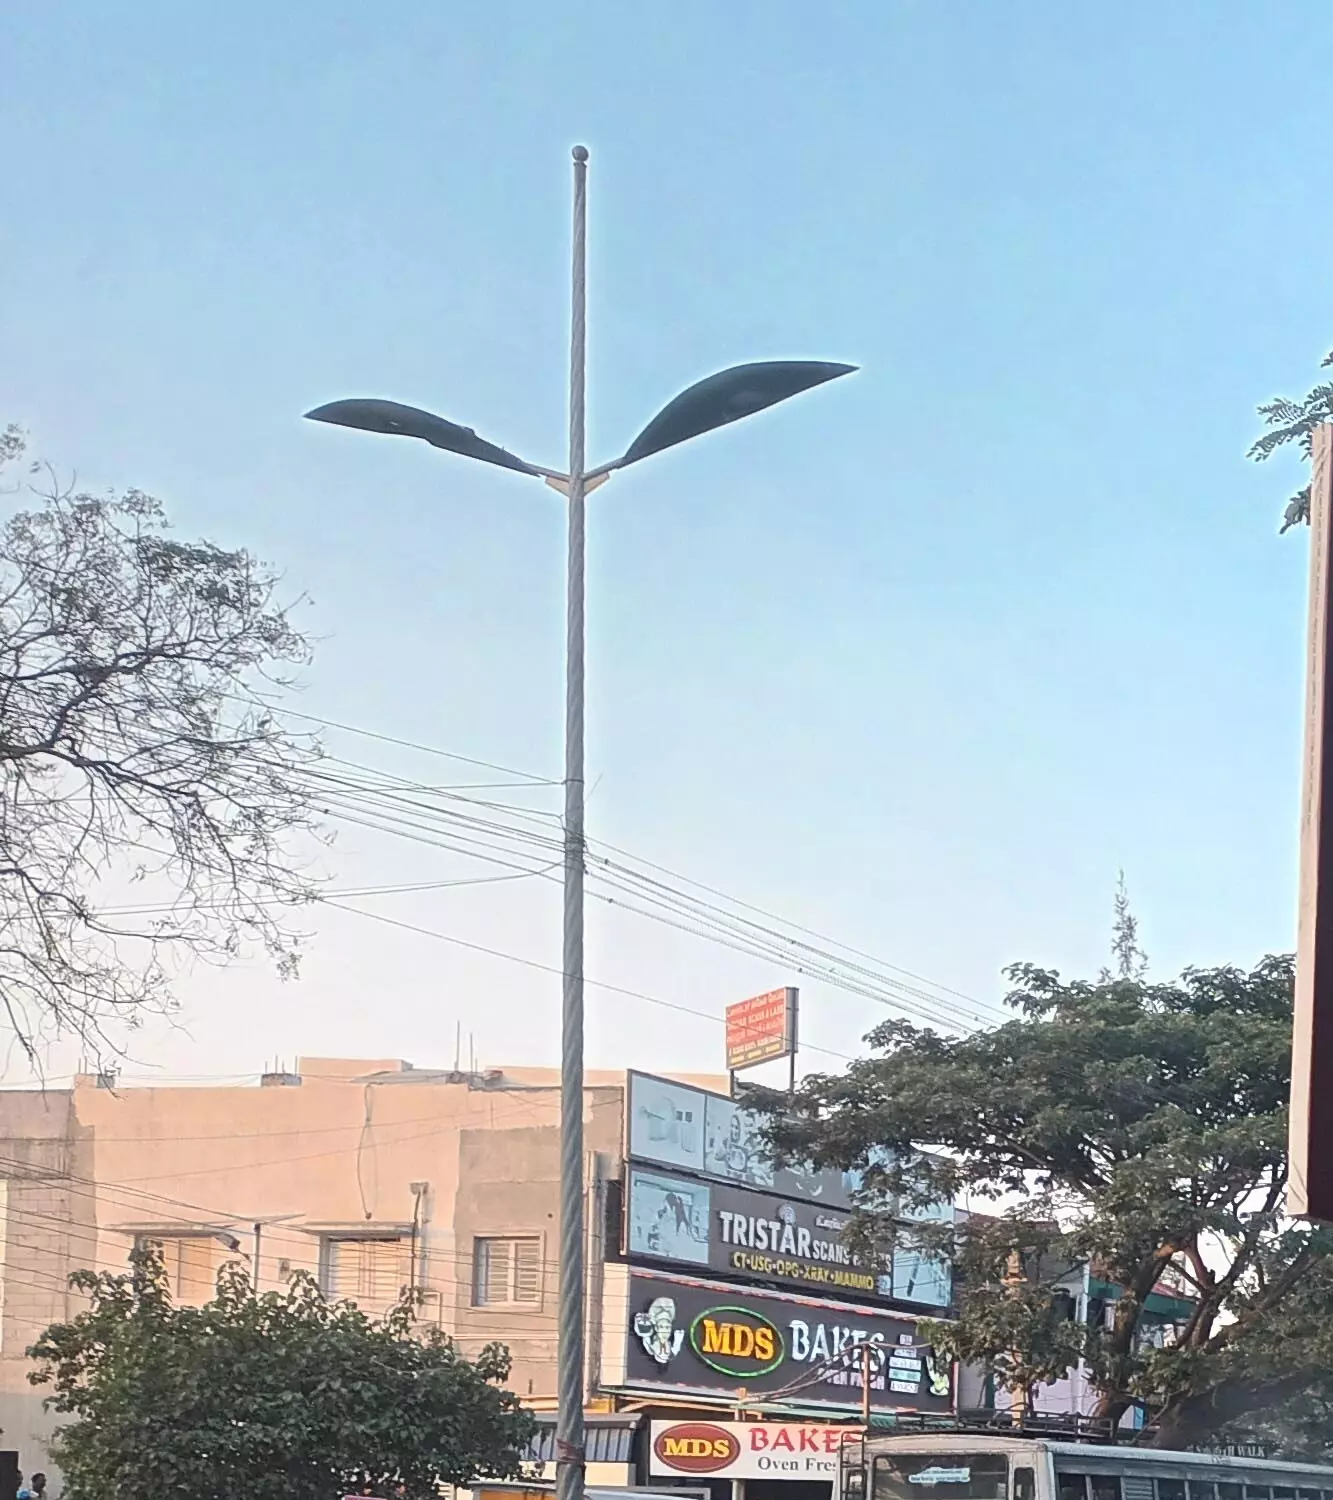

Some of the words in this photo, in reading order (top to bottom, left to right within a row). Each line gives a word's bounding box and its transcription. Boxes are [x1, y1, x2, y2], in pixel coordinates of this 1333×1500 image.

[719, 1210, 811, 1258] TRISTAR
[703, 1318, 774, 1360] MDS
[789, 1320, 886, 1372] BAKES
[663, 1437, 730, 1458] MDS
[758, 1456, 799, 1472] Oven
